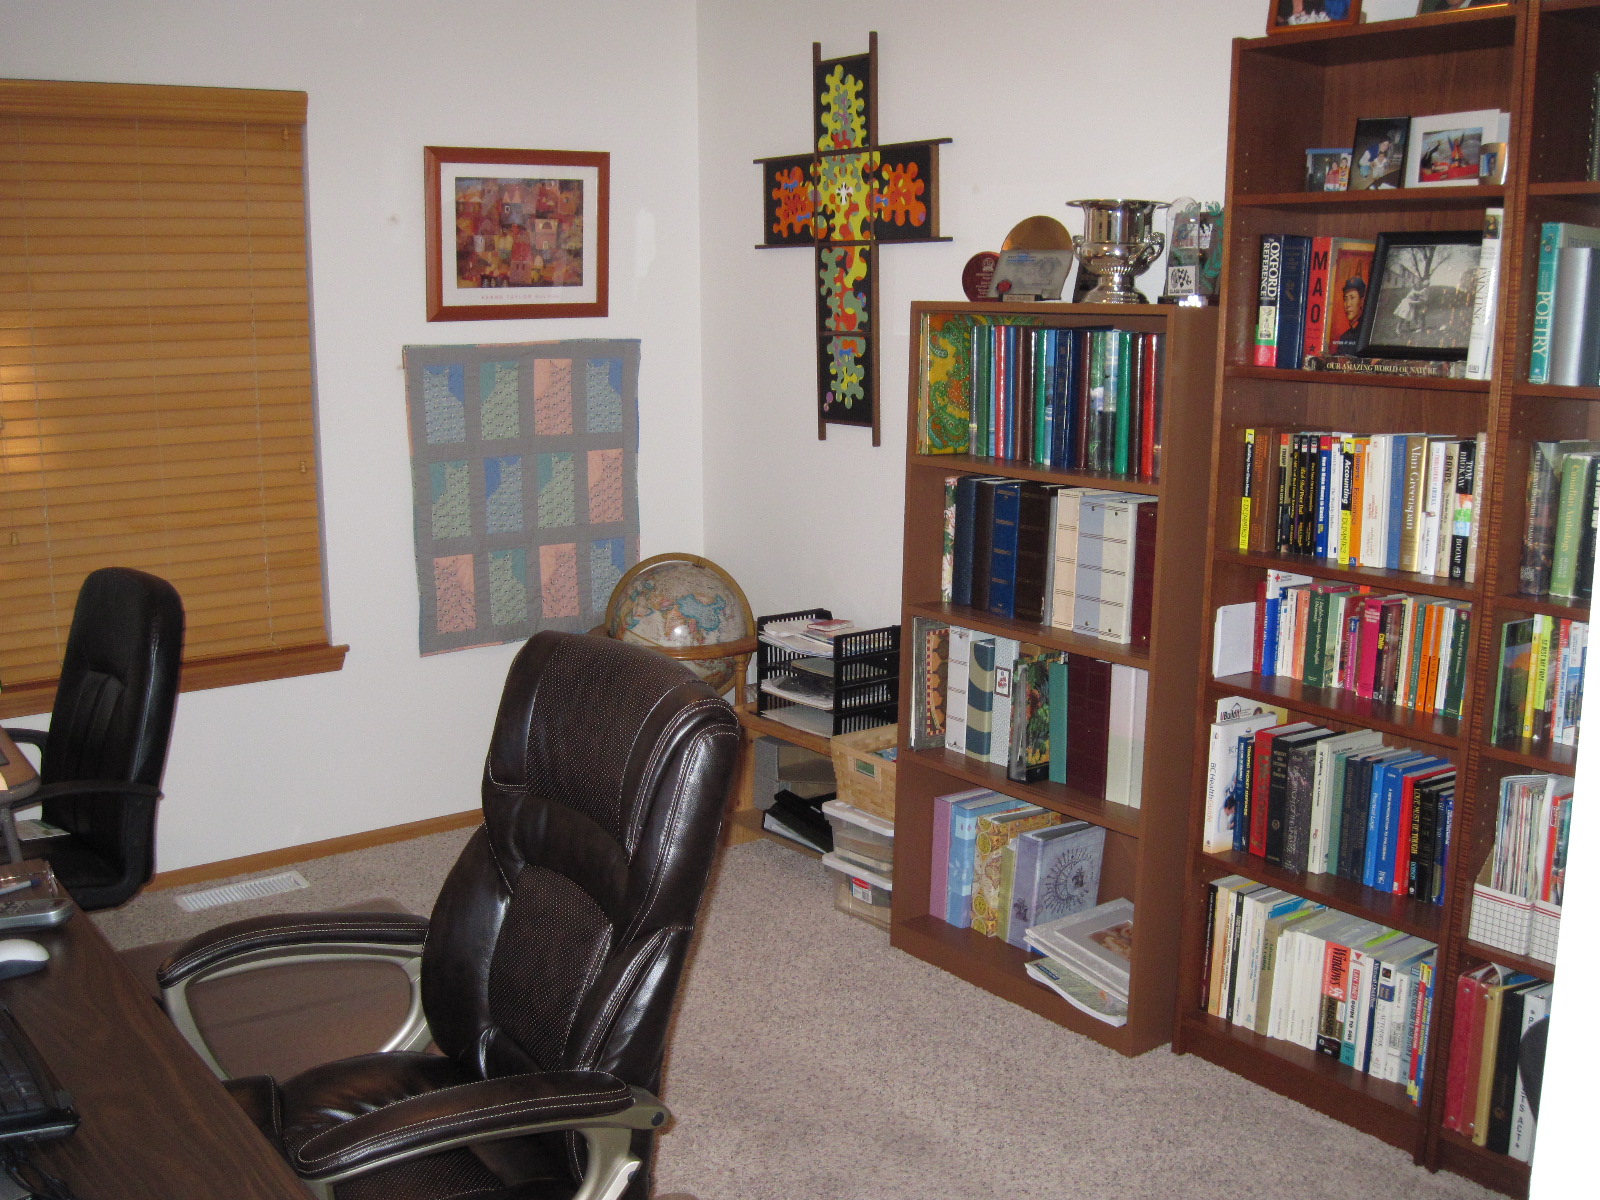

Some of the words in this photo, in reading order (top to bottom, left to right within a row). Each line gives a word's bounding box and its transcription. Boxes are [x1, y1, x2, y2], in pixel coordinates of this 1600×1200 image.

[1260, 242, 1270, 297] REFERENCE
[1267, 241, 1280, 298] OXFORD
[1531, 290, 1551, 358] POETRY
[1326, 362, 1341, 370] OUR
[1342, 362, 1373, 371] AMAZING
[1374, 364, 1398, 373] WORLD
[1410, 366, 1438, 375] NATURE
[1409, 445, 1422, 468] Alan
[1443, 455, 1453, 483] BONDS
[1457, 451, 1466, 488] BROKAW
[1464, 460, 1473, 479] TOM
[1341, 458, 1351, 504] Accounting
[1566, 464, 1580, 506] Canadian
[1351, 487, 1359, 524] Economics
[1402, 471, 1420, 529] Greenspan
[1560, 509, 1574, 552] Anthology
[1453, 538, 1462, 562] BOOM!
[1209, 762, 1216, 772] BC
[1250, 754, 1271, 848] Dictionary
[1370, 792, 1378, 815] Practical
[1413, 788, 1421, 804] LOVE
[1411, 823, 1419, 831] BE
[1412, 806, 1420, 821] MUST
[1410, 833, 1418, 854] TOUGH
[1328, 948, 1348, 985] Windows
[1351, 970, 1360, 981] LAN
[1328, 985, 1344, 998] 95
[1324, 996, 1338, 1036] UNLEASHED
[1377, 1014, 1386, 1047] AUTODESK
